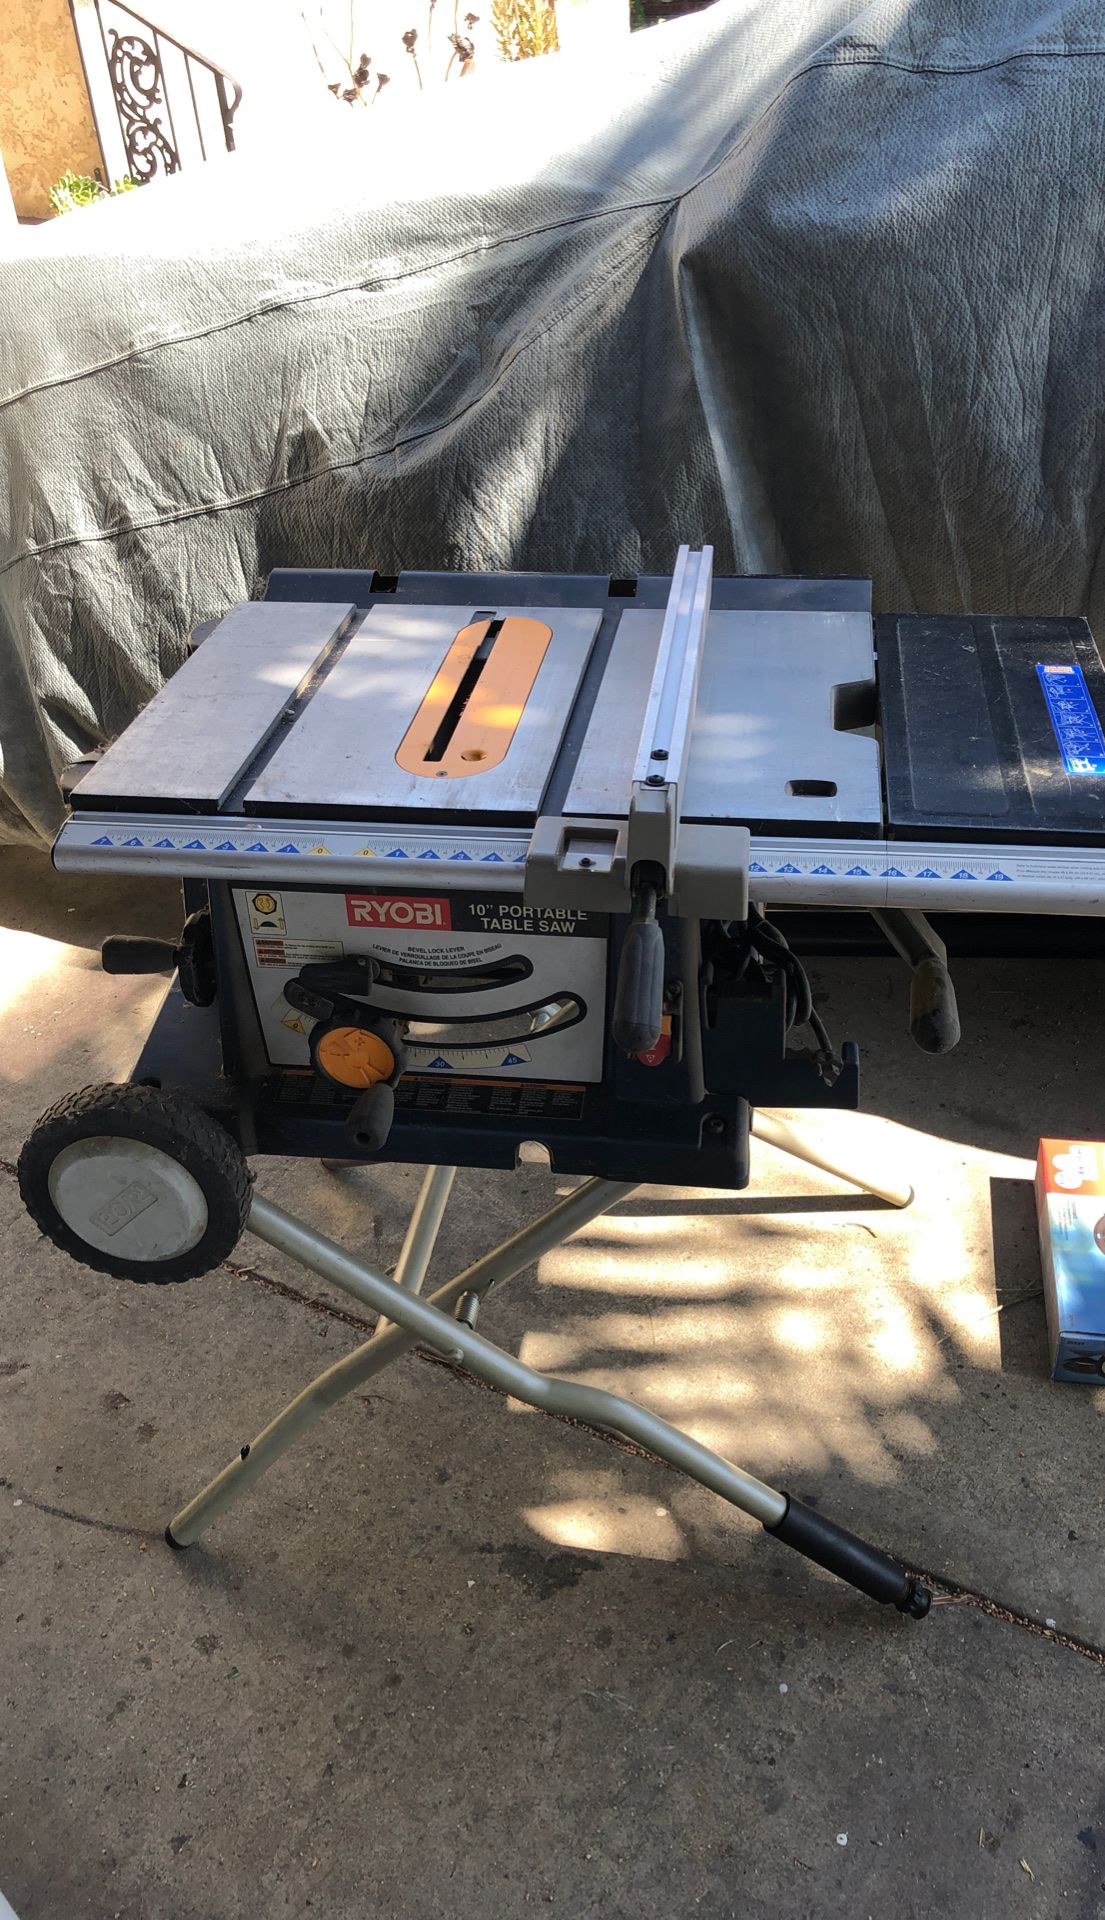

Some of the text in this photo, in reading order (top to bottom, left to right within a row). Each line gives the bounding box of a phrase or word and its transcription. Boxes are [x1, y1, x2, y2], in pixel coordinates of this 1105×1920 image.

[750, 864, 760, 872] 12
[818, 866, 828, 874] 14
[853, 867, 862, 875] 15
[888, 868, 898, 877] 16
[923, 870, 932, 878] 17
[959, 871, 969, 879] 18
[994, 872, 1004, 880] 19
[351, 900, 442, 925] RYOBI
[499, 905, 588, 921] PORTABLE
[480, 917, 576, 933] TABLE SAW
[372, 943, 391, 953] LEVIER
[457, 951, 476, 959] COUPE
[407, 946, 427, 954] BEVEL
[445, 946, 465, 954] LEVER
[399, 957, 424, 966] PALANCA
[434, 1056, 518, 1068] 30 45
